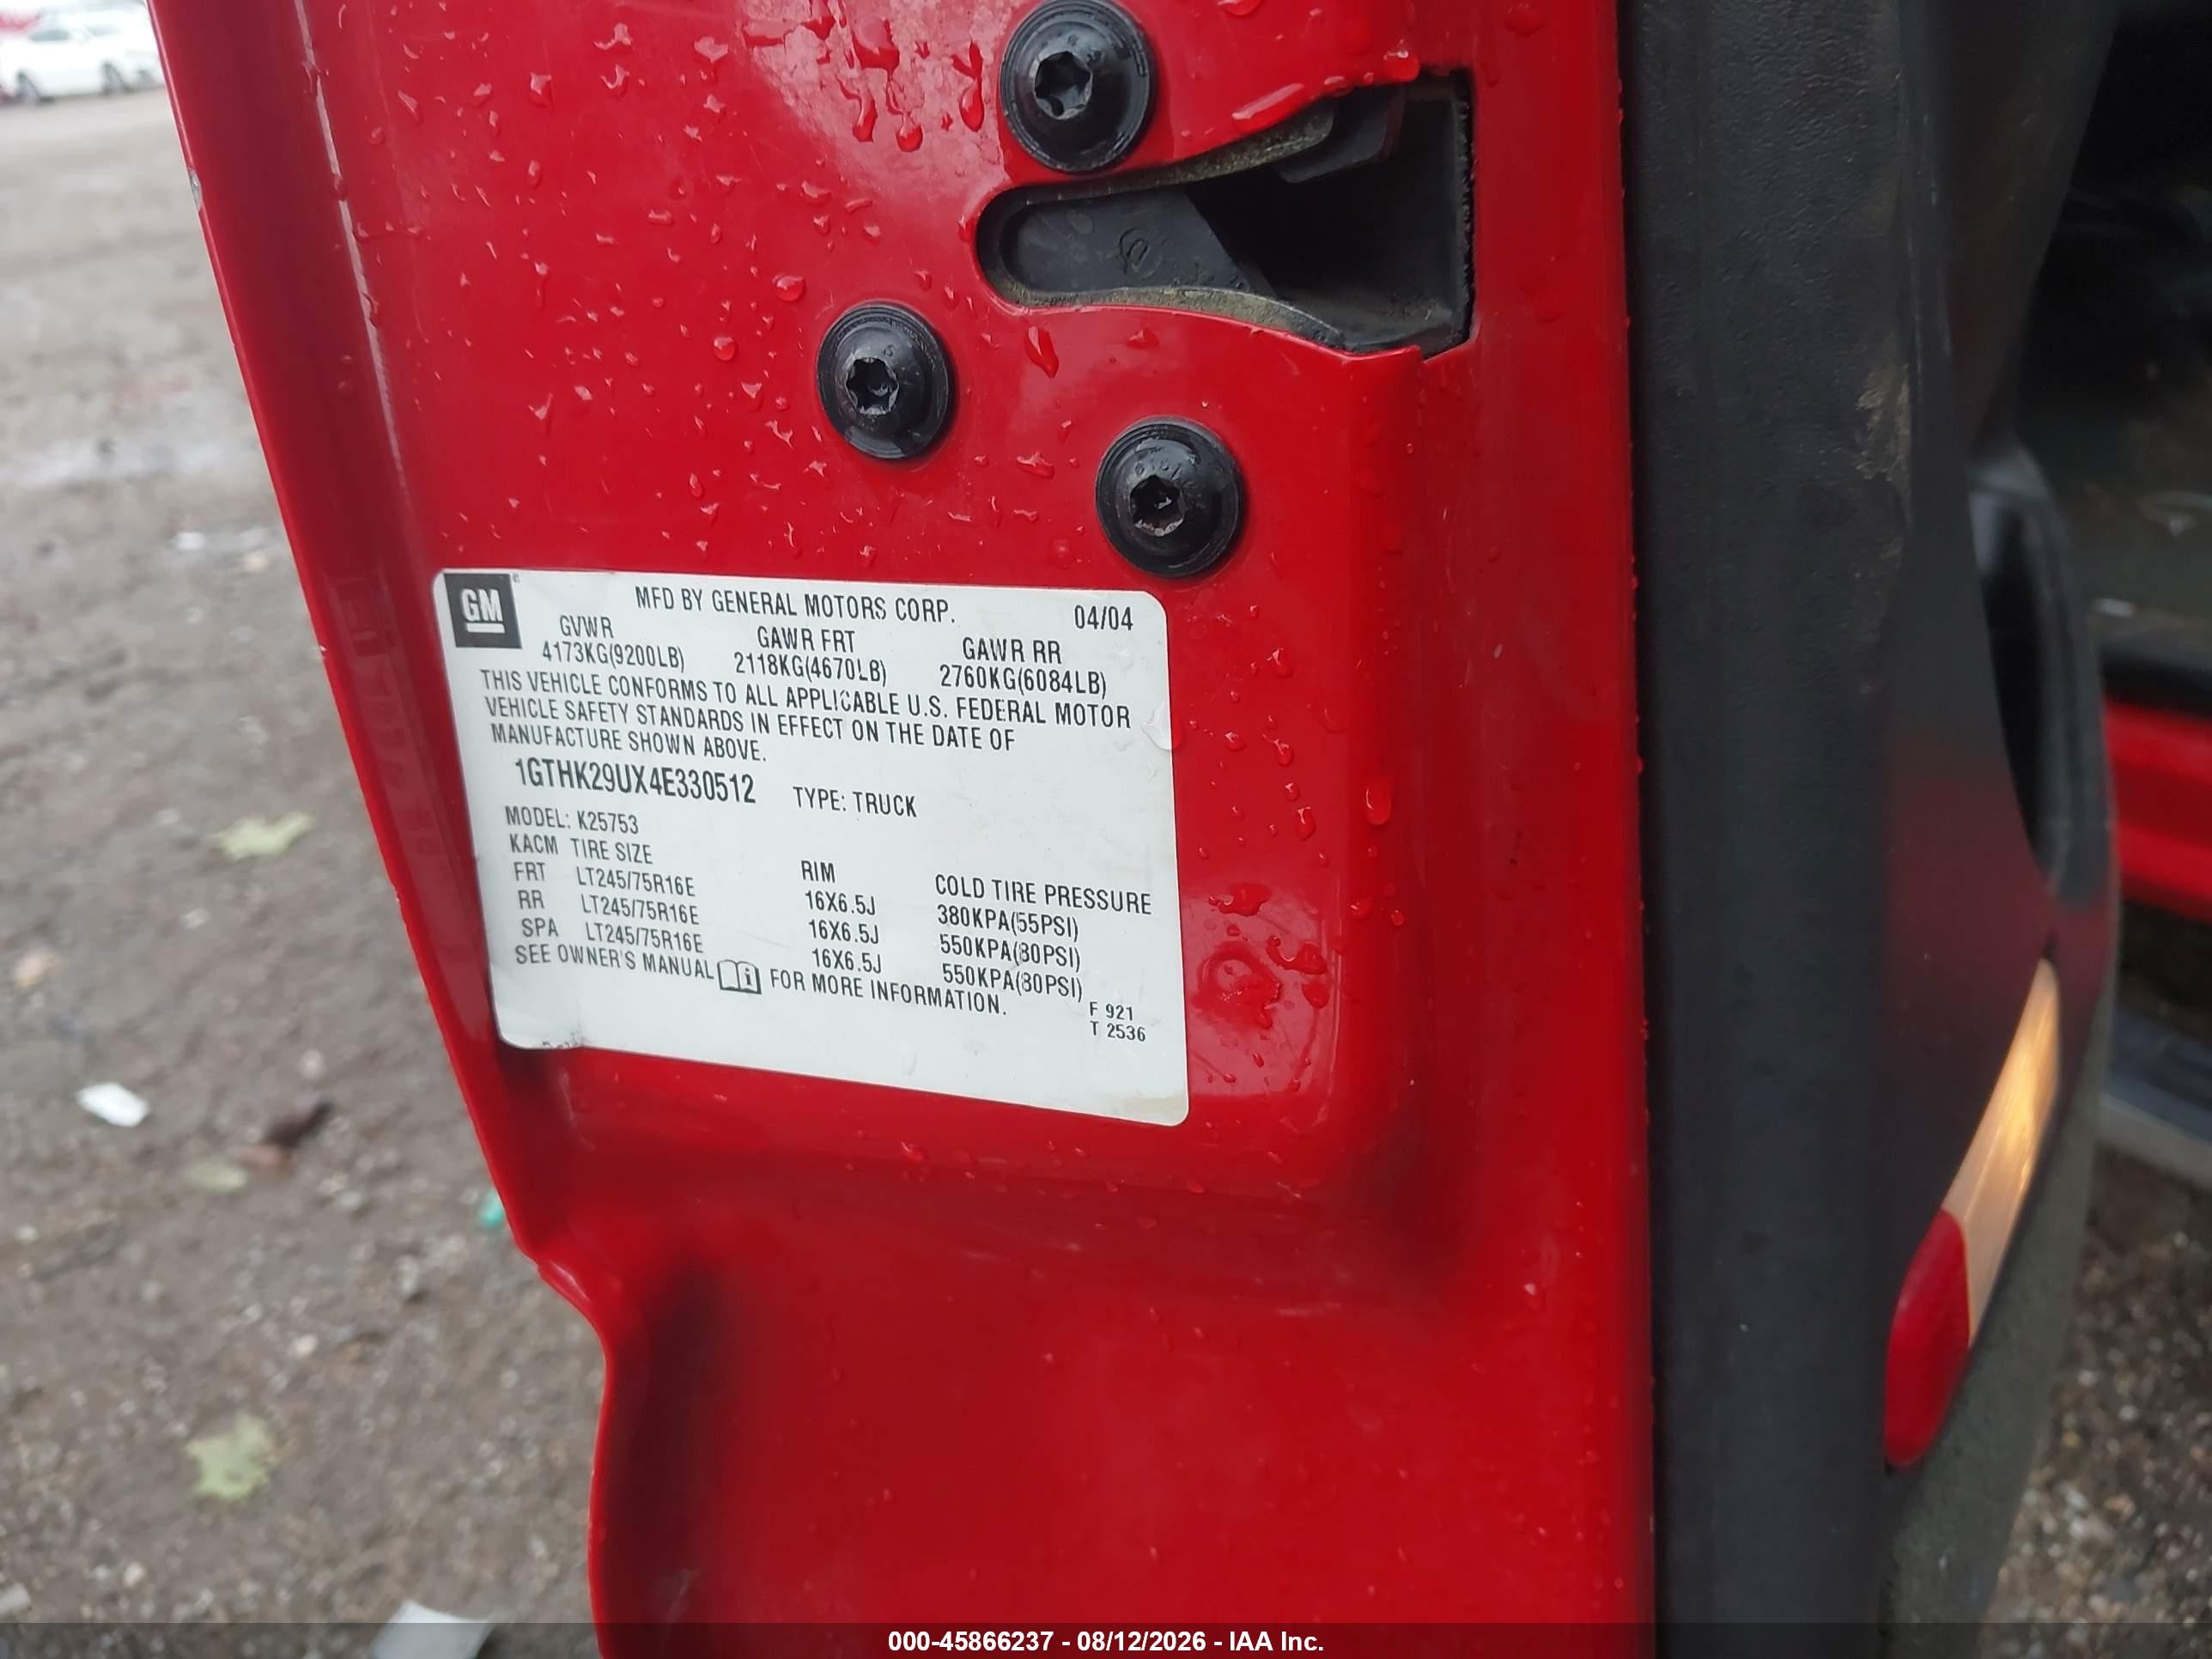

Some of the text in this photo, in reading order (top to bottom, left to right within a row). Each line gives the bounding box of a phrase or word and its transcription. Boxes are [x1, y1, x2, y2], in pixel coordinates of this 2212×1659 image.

[461, 588, 504, 623] GM
[635, 586, 956, 623] MFD BY GENERAL MOTORS CORP.
[1074, 605, 1133, 631] 04/04
[559, 615, 614, 639] GVWR
[757, 625, 855, 653] GAWR FRT
[542, 640, 685, 673] 4173KG(9200LB)
[962, 636, 1062, 665] GAWR RR
[733, 651, 887, 687] 2118KG(4670LB)
[939, 664, 1107, 700] 2760KG(6084LB)
[480, 669, 1131, 729] THIS VEHICLE CONFORMS TO ALL APPLICABLE U.S. FEDERAL MOTOR
[484, 696, 1016, 751] VEHICLE SAFETY STANDARDS IN EFFECT ON THE DATE OF
[490, 723, 767, 762] MANUFACTURE SHOWN ABOVE.
[515, 757, 757, 804] 1GTHK29UX4E330512
[793, 786, 917, 817] TYPE: TRUCK
[504, 805, 639, 835] MODEL: K25753
[509, 833, 653, 865] KACM TIRE SIZE
[514, 861, 696, 897] FRT LT245/75R16E
[801, 860, 836, 884] RIM
[518, 890, 700, 926] RR LT245/75R16E
[805, 890, 876, 915] 16X6.5J
[935, 873, 1152, 915] COLD TIRE PRESSURE
[520, 918, 704, 954] SPA LT245/75R16E
[808, 919, 879, 945] 16X6.5J
[937, 904, 1079, 943] 380KPA(55PSI)
[811, 948, 882, 974] 16X6.5J
[515, 943, 1006, 1015] SEE OWNER'S MANUAL FOR MORE INFORMATION.
[1089, 1001, 1133, 1021] F 921
[1090, 1020, 1146, 1042] T 2536
